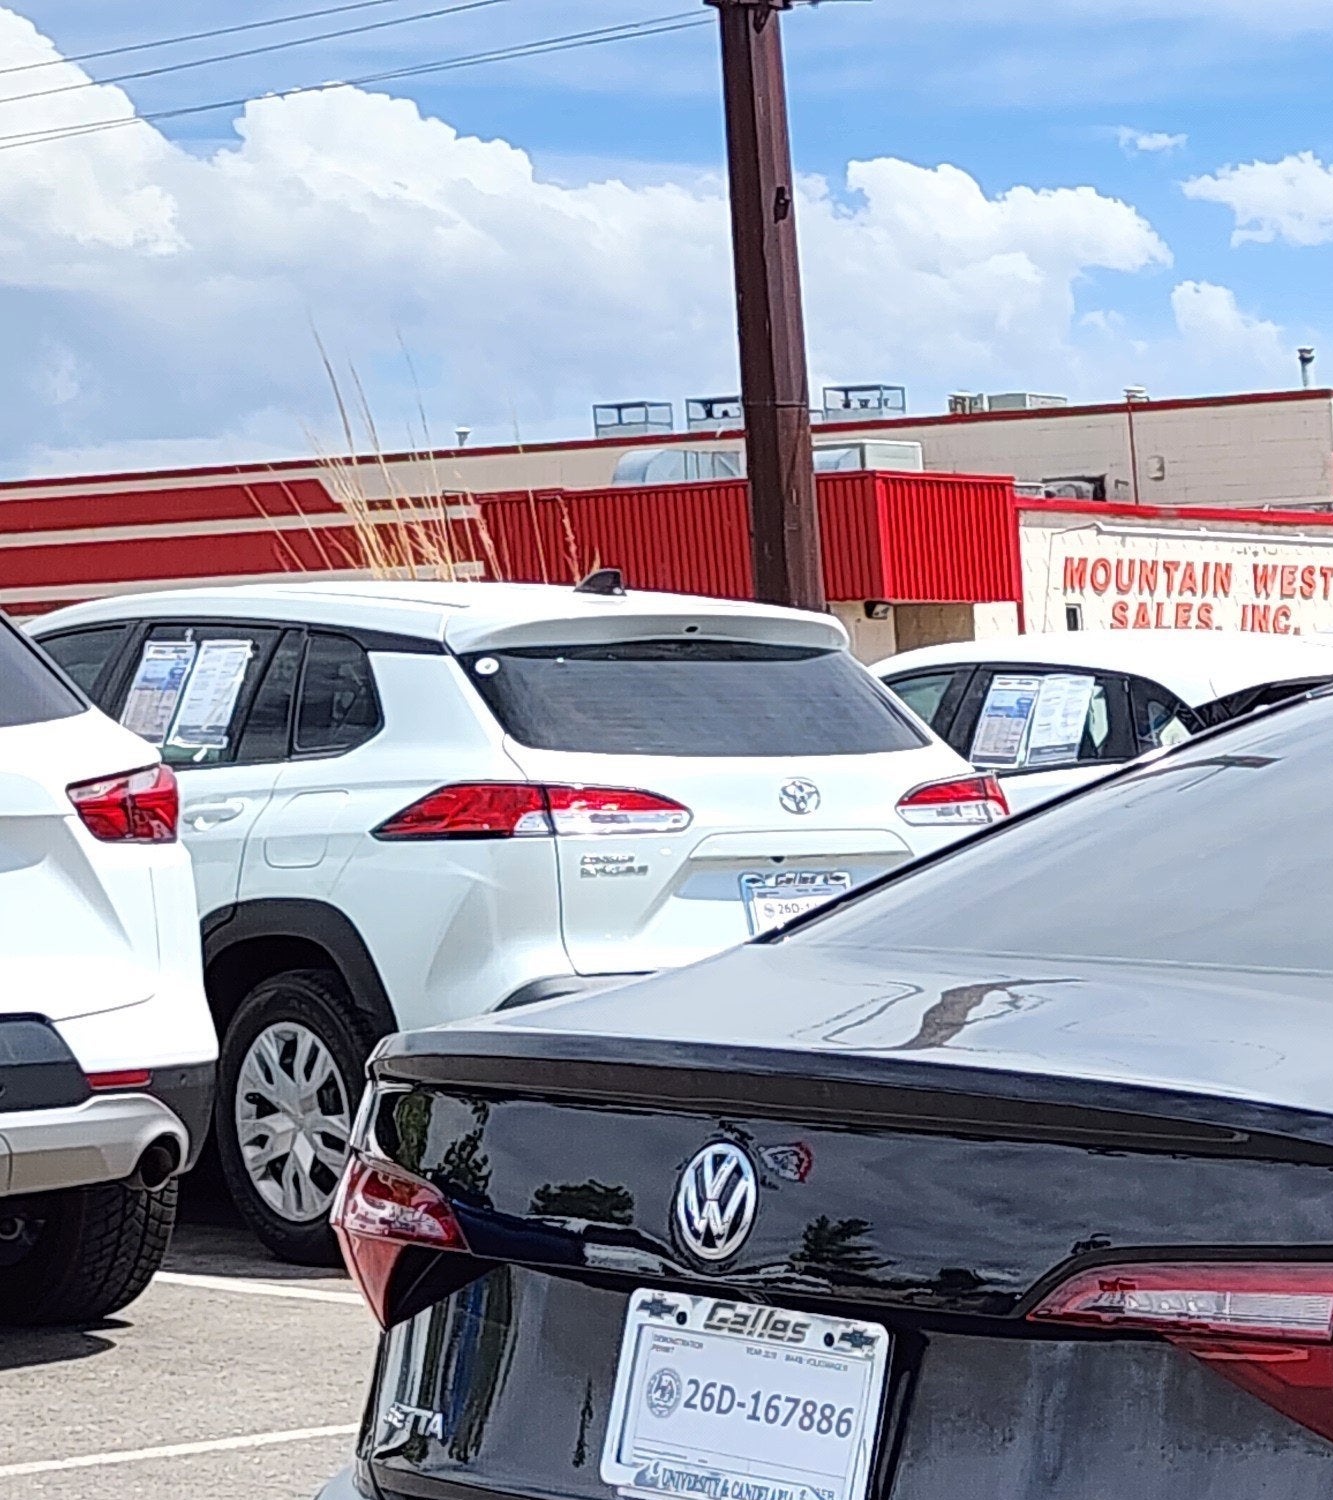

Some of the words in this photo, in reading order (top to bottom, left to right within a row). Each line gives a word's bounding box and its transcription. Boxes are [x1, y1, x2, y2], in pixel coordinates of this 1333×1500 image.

[1063, 556, 1233, 598] MOUNTAIN
[703, 1301, 812, 1344] Galles
[683, 1378, 855, 1439] 26D-167886
[661, 1468, 721, 1499] UNIVERSITY
